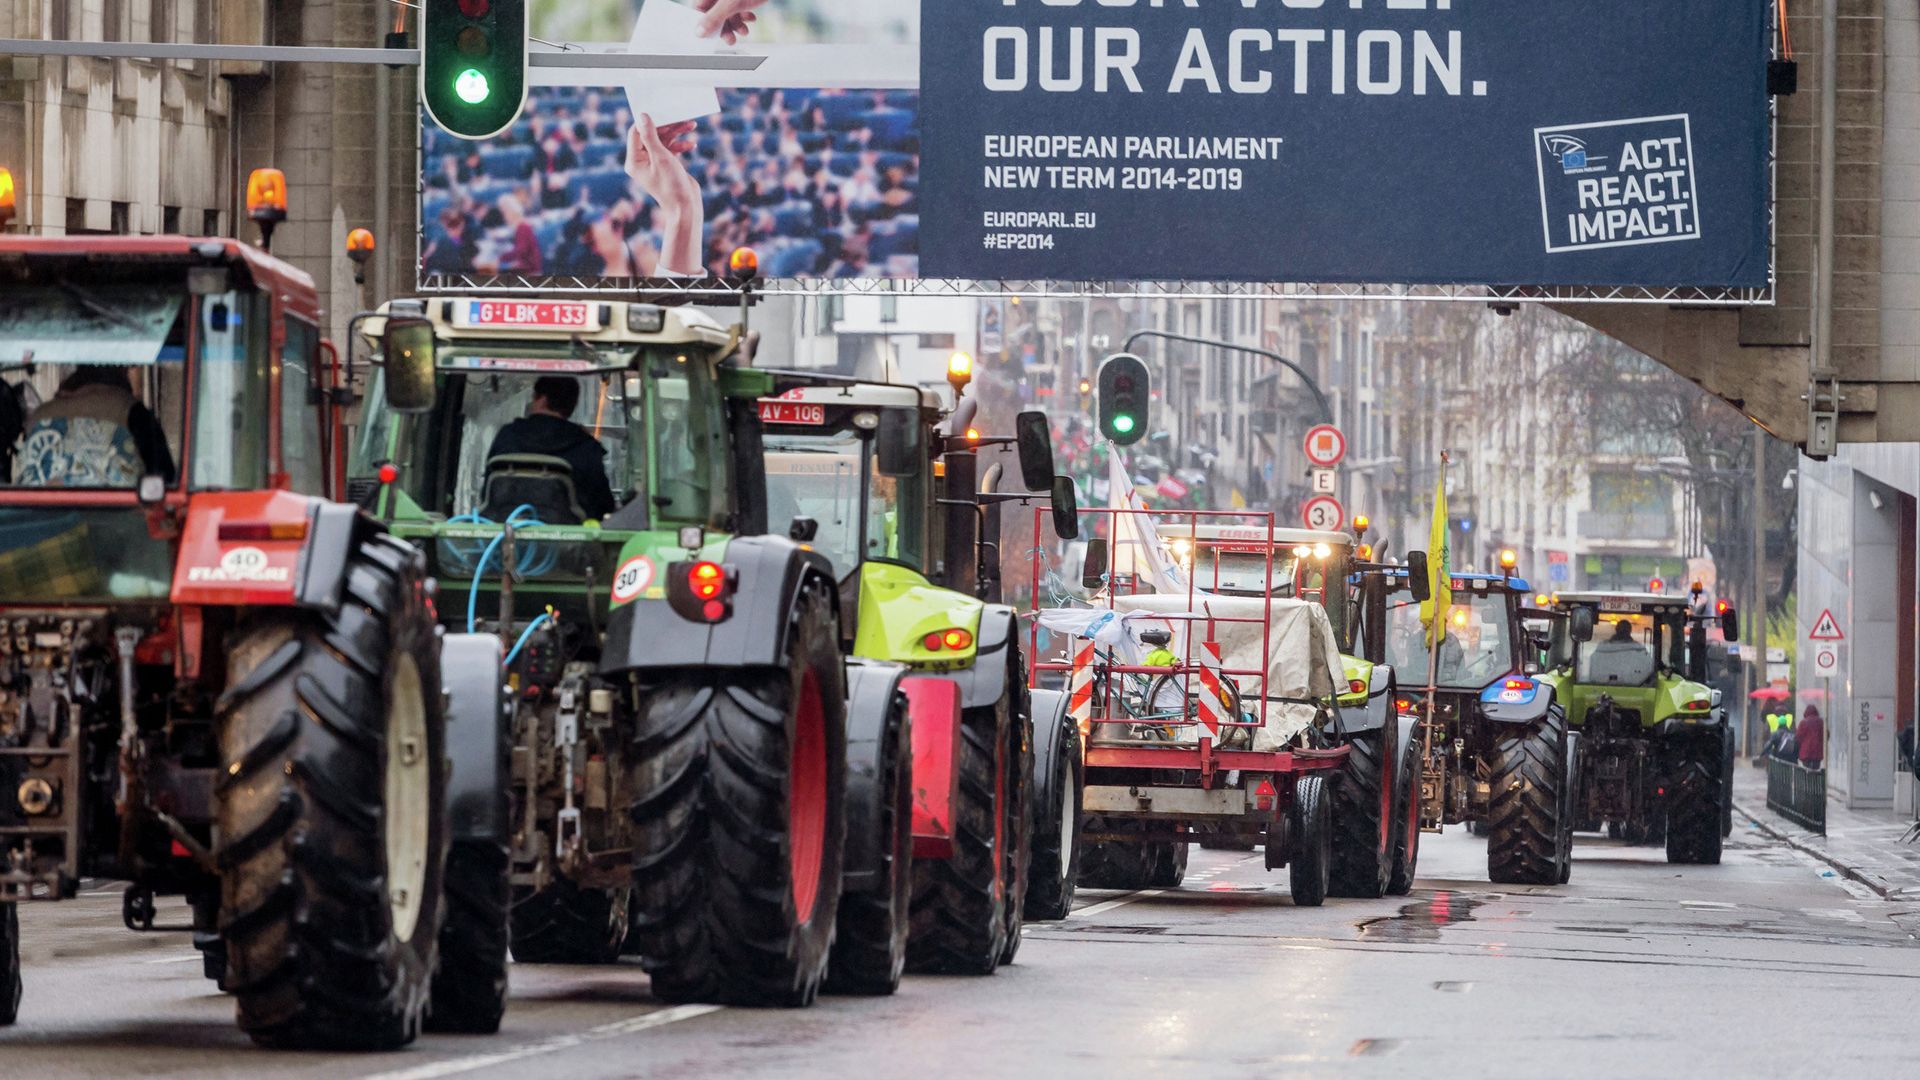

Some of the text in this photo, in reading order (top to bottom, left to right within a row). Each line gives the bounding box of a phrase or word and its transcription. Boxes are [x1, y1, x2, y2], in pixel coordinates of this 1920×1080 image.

[983, 26, 1487, 95] OUR ACTION.
[985, 135, 1283, 160] EUROPEAN PARLIAMENT
[1619, 137, 1686, 171] ACT.
[985, 166, 1242, 190] NEW TERM 2014-2019
[1578, 170, 1689, 209] REACT.
[984, 212, 1096, 228] EUROPARL.EU
[1569, 203, 1692, 243] IMPACT.
[984, 234, 1054, 249] #EP2014
[1320, 473, 1329, 489] E
[231, 553, 258, 565] 40
[1858, 702, 1870, 741] Delors
